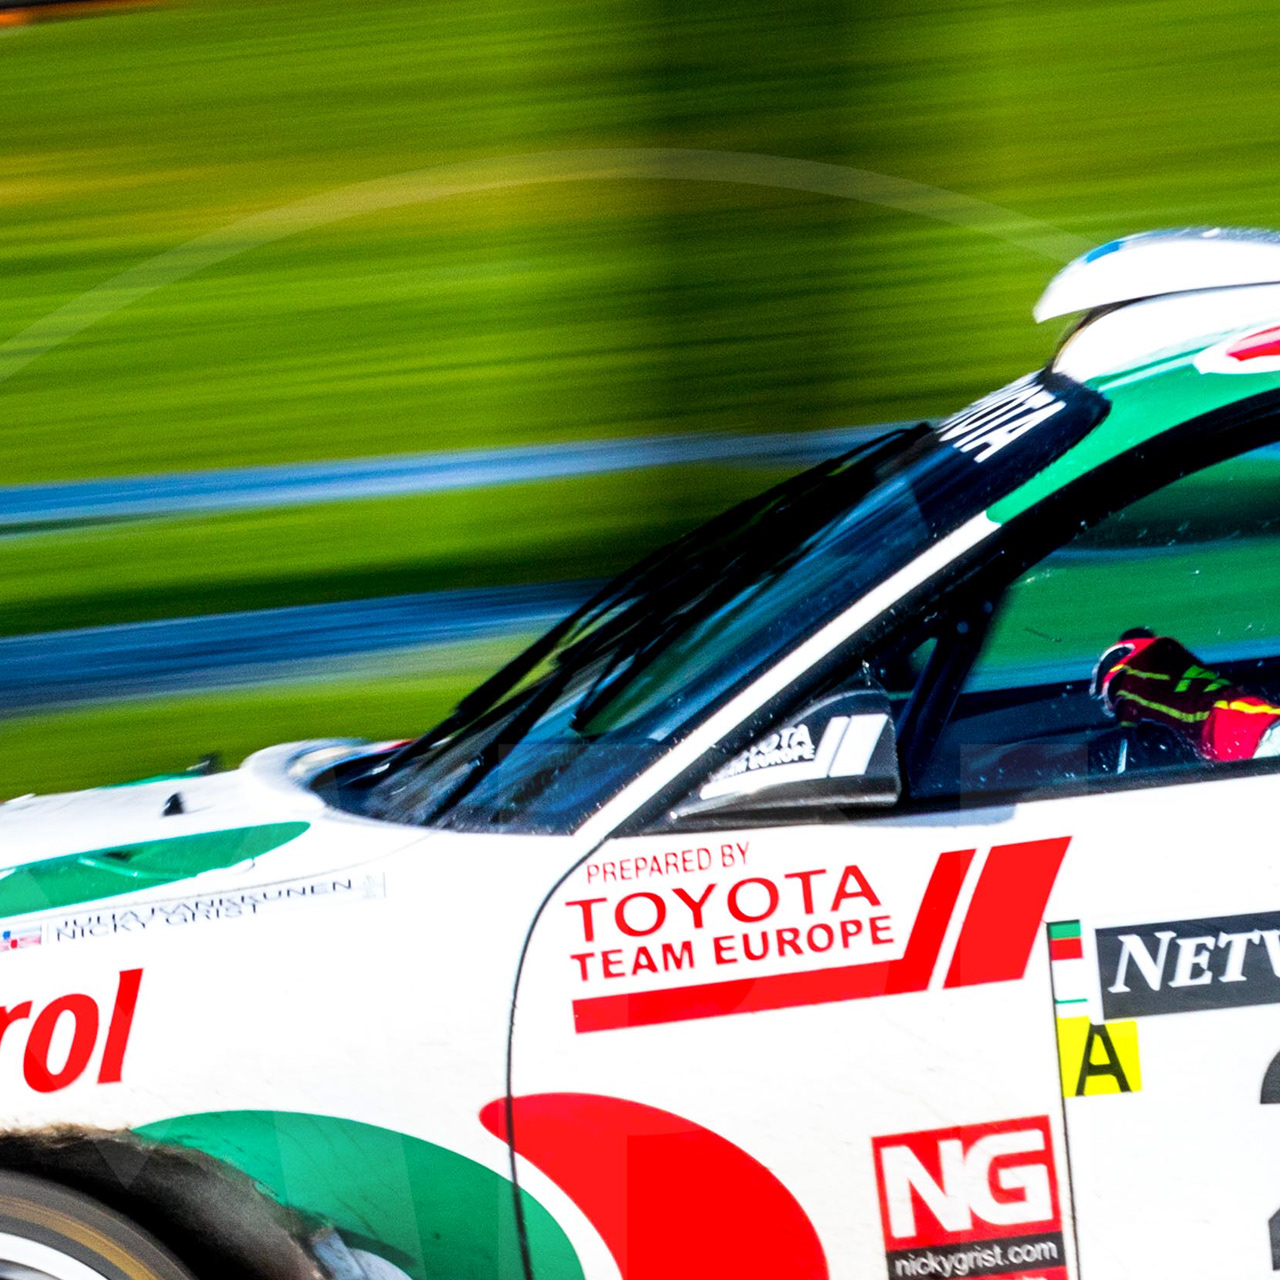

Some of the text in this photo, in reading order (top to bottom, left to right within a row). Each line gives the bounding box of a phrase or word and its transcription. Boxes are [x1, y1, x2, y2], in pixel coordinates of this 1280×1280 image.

[586, 841, 750, 884] PREPARED BY
[565, 864, 883, 942] TOYOTA
[570, 915, 895, 981] TEAM EUROPE
[1075, 1023, 1131, 1097] A
[880, 1128, 1053, 1240] NG
[894, 1241, 1058, 1277] nickygrist.com
